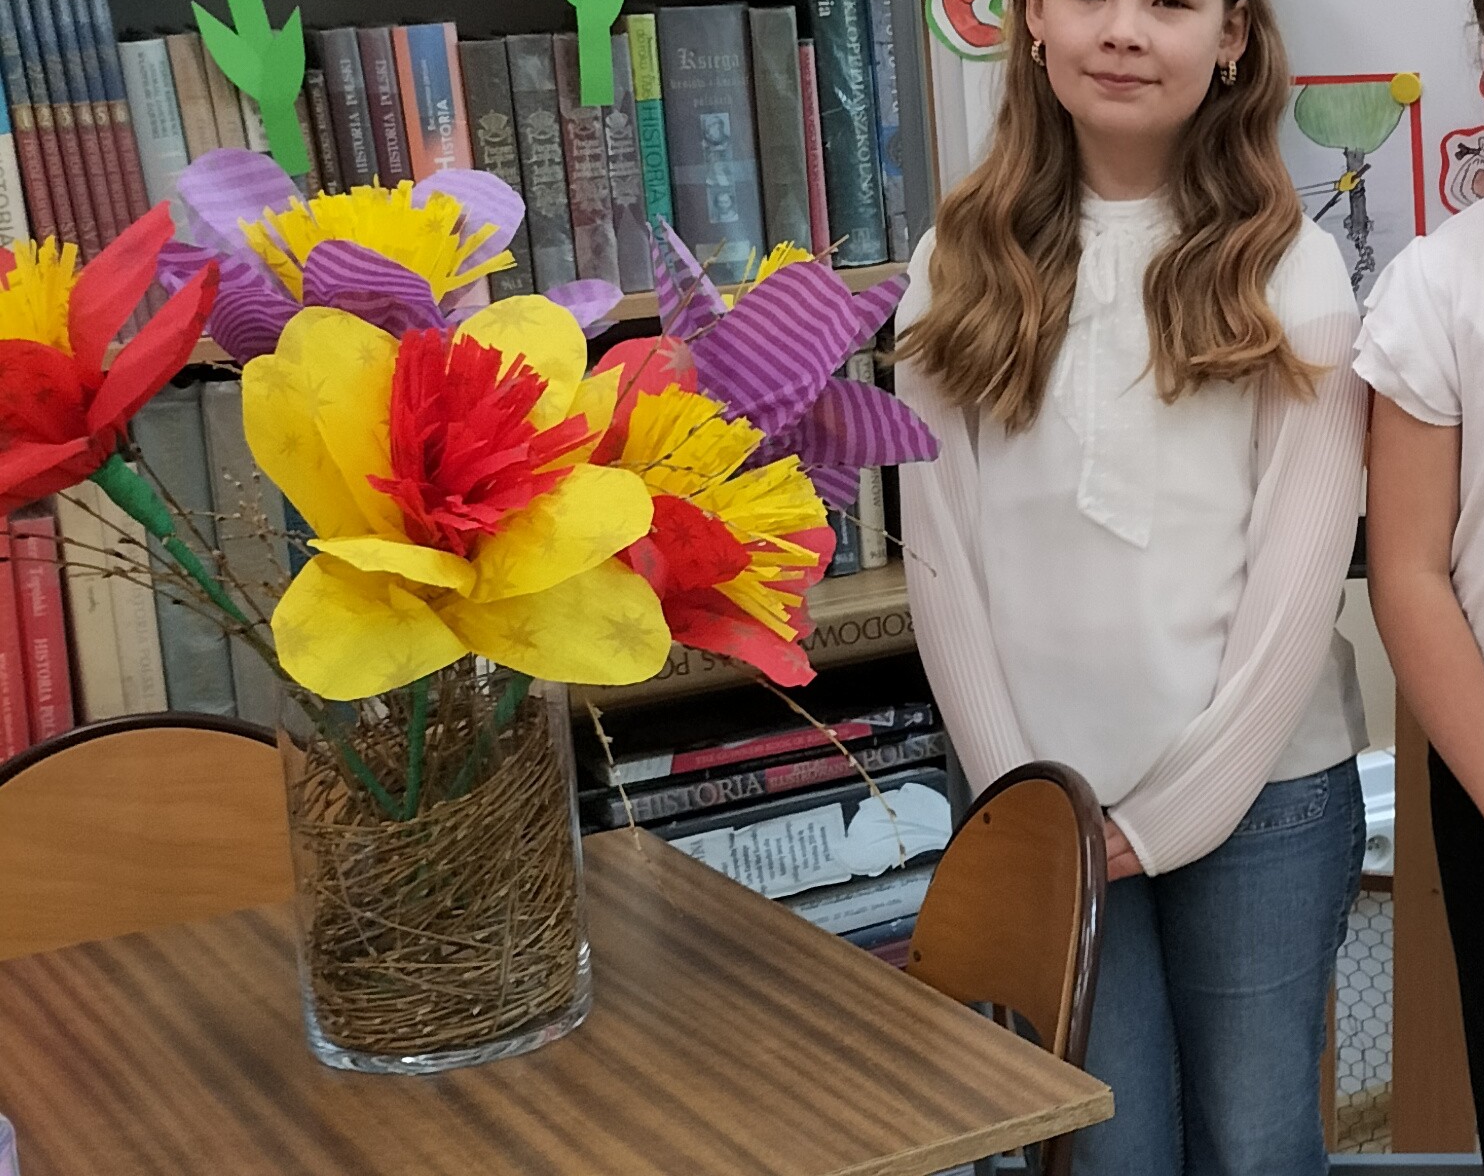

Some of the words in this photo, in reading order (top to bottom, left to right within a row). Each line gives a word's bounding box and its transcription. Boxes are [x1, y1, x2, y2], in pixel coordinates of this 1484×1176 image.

[339, 59, 358, 106] POLSKI
[375, 59, 393, 106] POLSKI
[349, 112, 369, 174] HISTORIA
[383, 112, 403, 174] HISTORIA
[642, 104, 665, 204] HISTORIA
[33, 638, 52, 702] HISTORIA
[633, 773, 765, 823] HISTORIA
